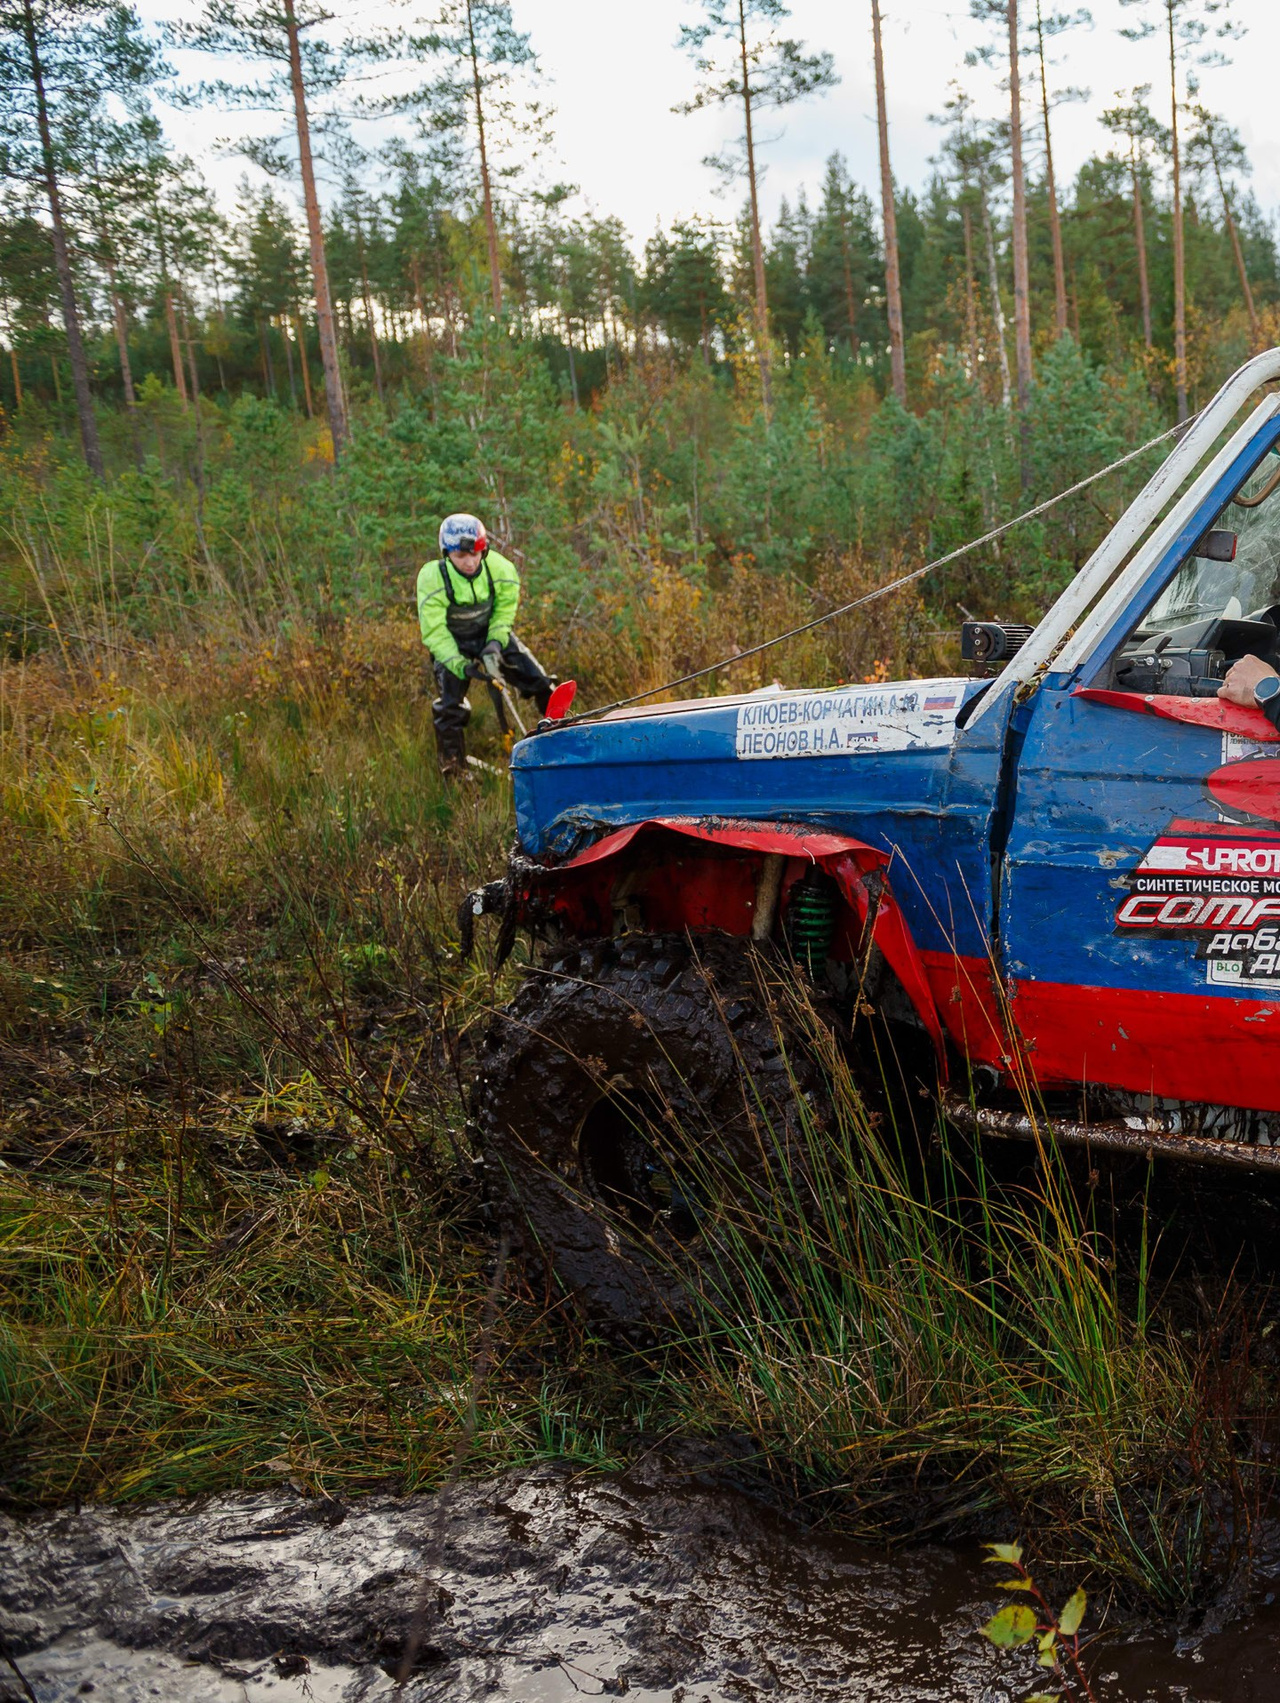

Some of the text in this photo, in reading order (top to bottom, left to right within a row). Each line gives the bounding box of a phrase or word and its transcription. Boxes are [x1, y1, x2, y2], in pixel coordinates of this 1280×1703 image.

[742, 728, 843, 754] ЛЕОНОВ Н.А.
[1136, 878, 1259, 894] СИНТЕТИЧЕСКОЕ
